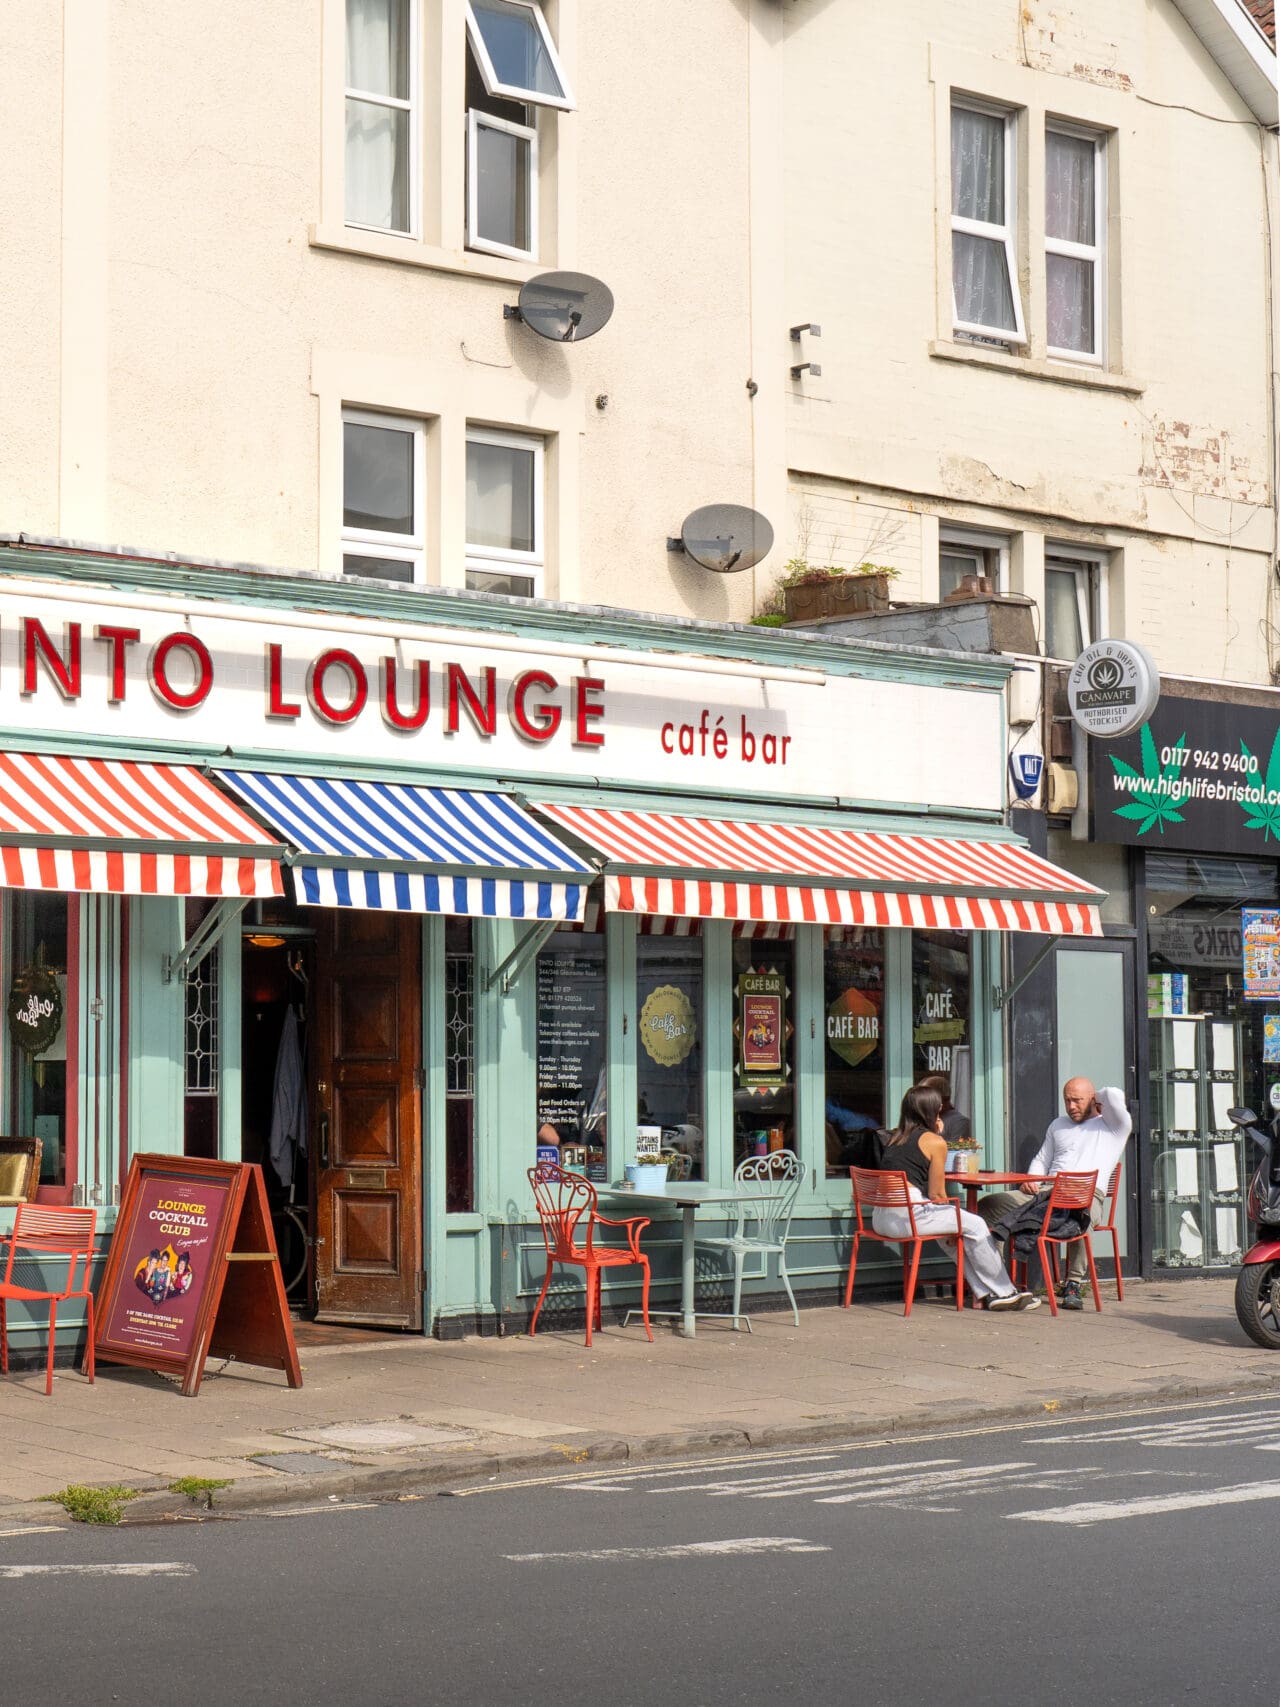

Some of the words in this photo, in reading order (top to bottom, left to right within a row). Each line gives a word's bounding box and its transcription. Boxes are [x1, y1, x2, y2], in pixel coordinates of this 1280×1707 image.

[1073, 663, 1086, 684] CBD
[1086, 648, 1102, 662] OIL
[1117, 650, 1138, 679] VAPES
[264, 642, 606, 749] LOUNGE
[1084, 707, 1128, 718] AUTHORISED
[1088, 716, 1122, 726] STOCKIST
[660, 709, 728, 760] café
[741, 715, 793, 766] bar
[1161, 747, 1190, 766] 0117
[1194, 750, 1218, 770] 942
[1222, 753, 1259, 774] 9400
[744, 976, 764, 990] CAFÉ
[765, 980, 780, 991] BAR
[926, 988, 953, 1018] CAFÉ
[666, 1024, 686, 1040] Bar
[828, 1011, 854, 1038] CAFÉ
[858, 1017, 879, 1039] BAR
[928, 1046, 950, 1072] BAR
[157, 1200, 206, 1214] LOUNGE
[149, 1210, 208, 1226] COCKTAIL
[160, 1224, 191, 1236] CLUB
